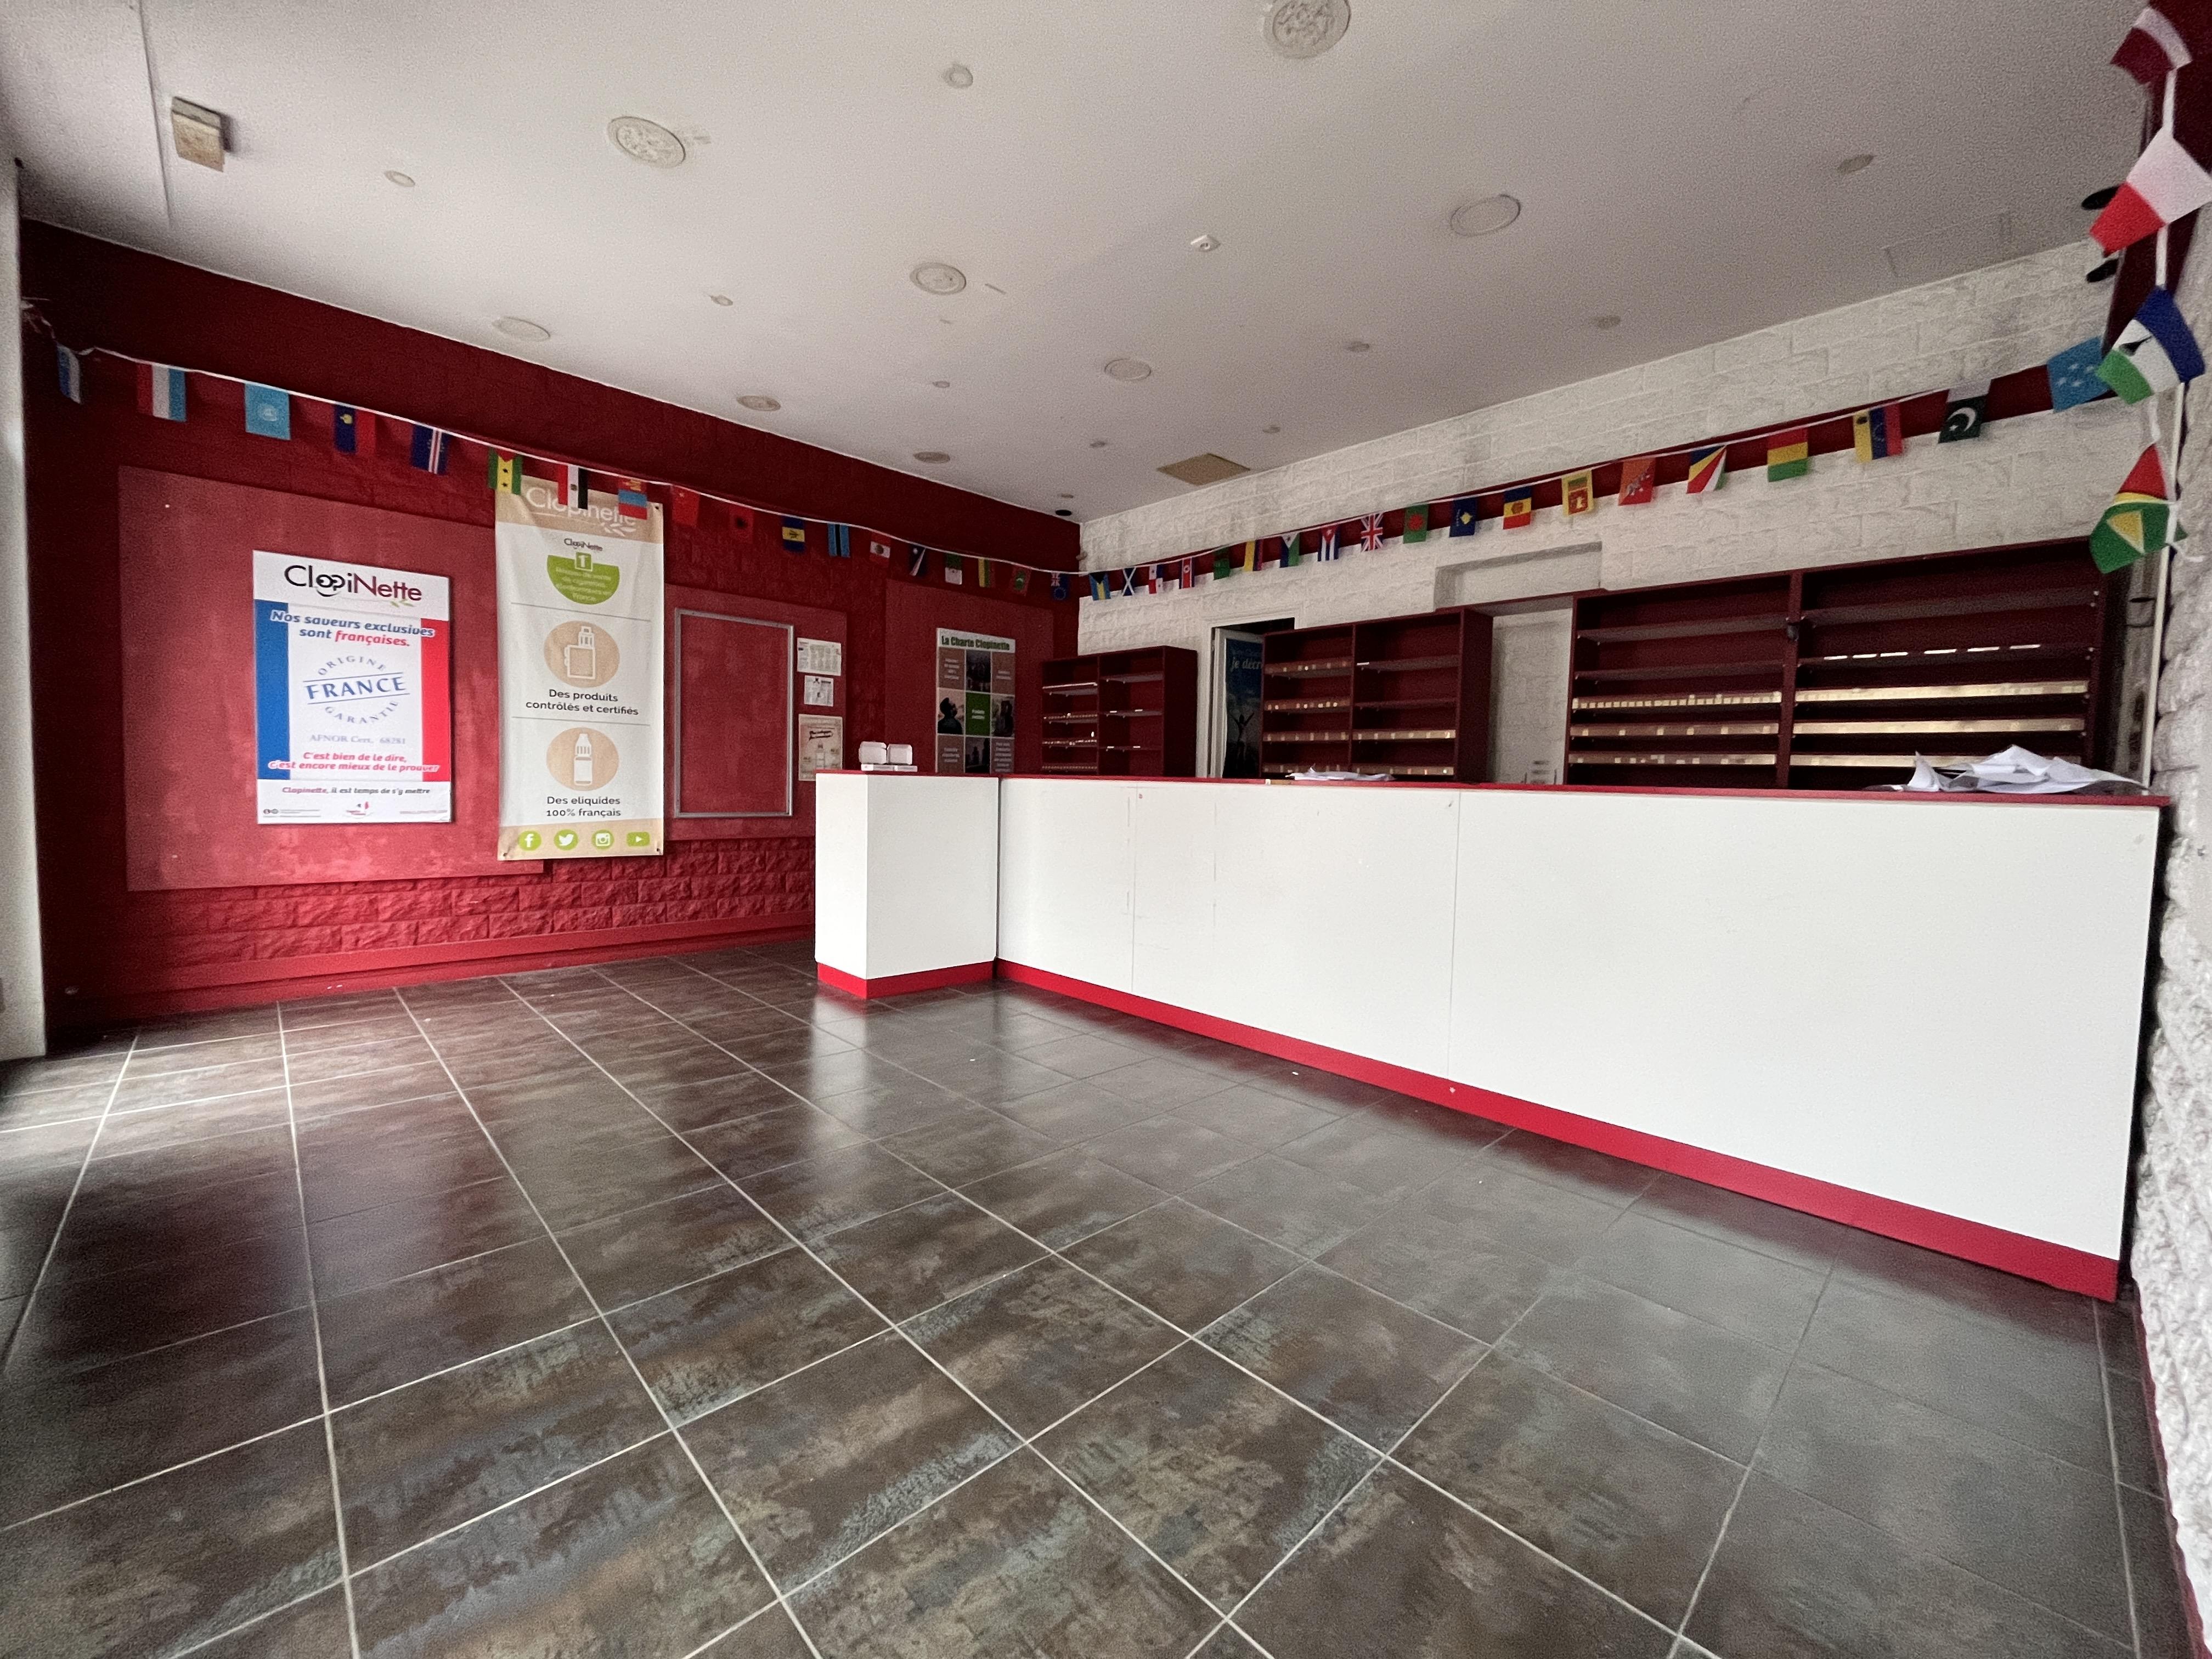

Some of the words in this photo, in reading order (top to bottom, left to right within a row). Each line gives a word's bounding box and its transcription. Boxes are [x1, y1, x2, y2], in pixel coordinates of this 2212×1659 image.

[272, 611, 300, 623] Nos
[304, 615, 360, 629] saveurs
[364, 622, 433, 637] exclusives
[299, 628, 332, 639] sont
[335, 630, 410, 646] françaises.
[941, 636, 950, 645] La
[951, 636, 974, 647] Charte
[317, 655, 385, 676] ORIGINE
[305, 676, 407, 700] FRANCE
[549, 689, 570, 699] Des
[573, 692, 618, 702] produits
[324, 699, 399, 724] GARANTIE
[596, 706, 639, 716] certifiés
[309, 733, 347, 743] AFNOR
[303, 752, 330, 760] C'est
[332, 752, 356, 761] bien
[385, 754, 407, 763] dire,
[298, 761, 335, 770] encore
[338, 762, 370, 770] mieux
[546, 796, 568, 804] Des
[571, 796, 621, 806] eliquides
[546, 808, 575, 817] 100%
[578, 808, 622, 818] français
